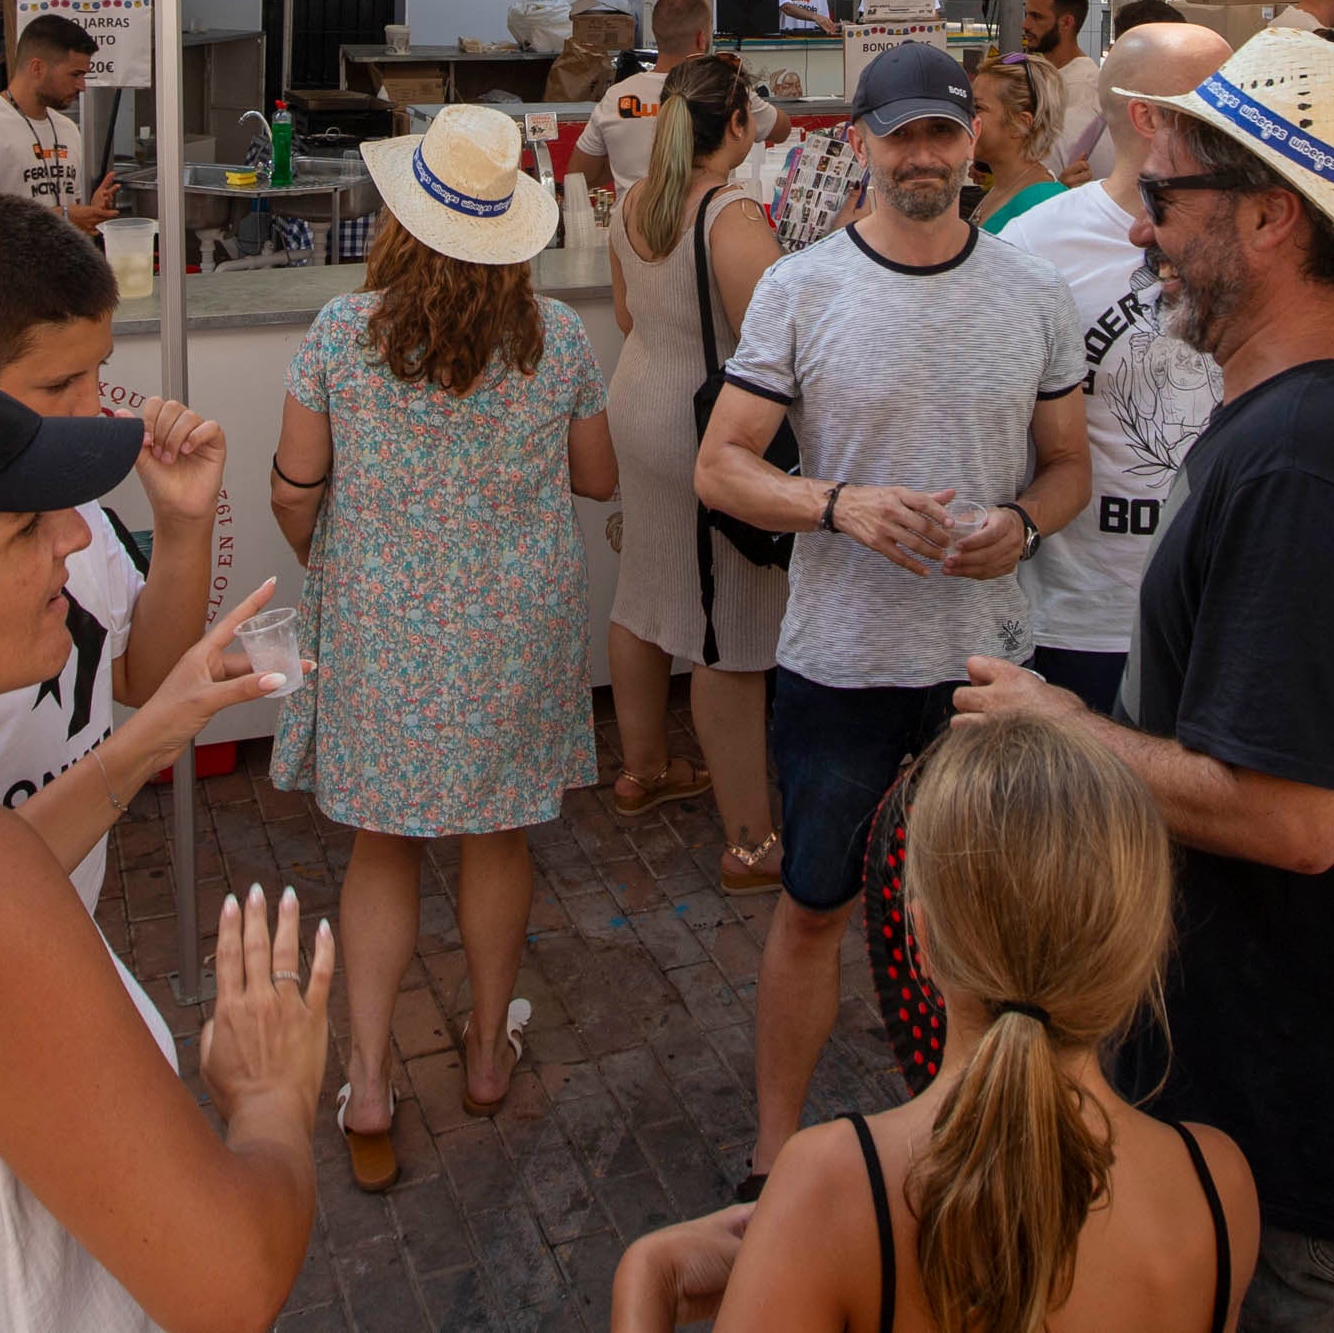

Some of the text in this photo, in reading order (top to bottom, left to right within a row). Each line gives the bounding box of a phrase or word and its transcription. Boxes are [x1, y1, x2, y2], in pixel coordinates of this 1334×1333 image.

[83, 17, 130, 29] JARRAS
[862, 42, 895, 54] BONO
[948, 85, 968, 98] BOSS
[217, 535, 234, 569] EN
